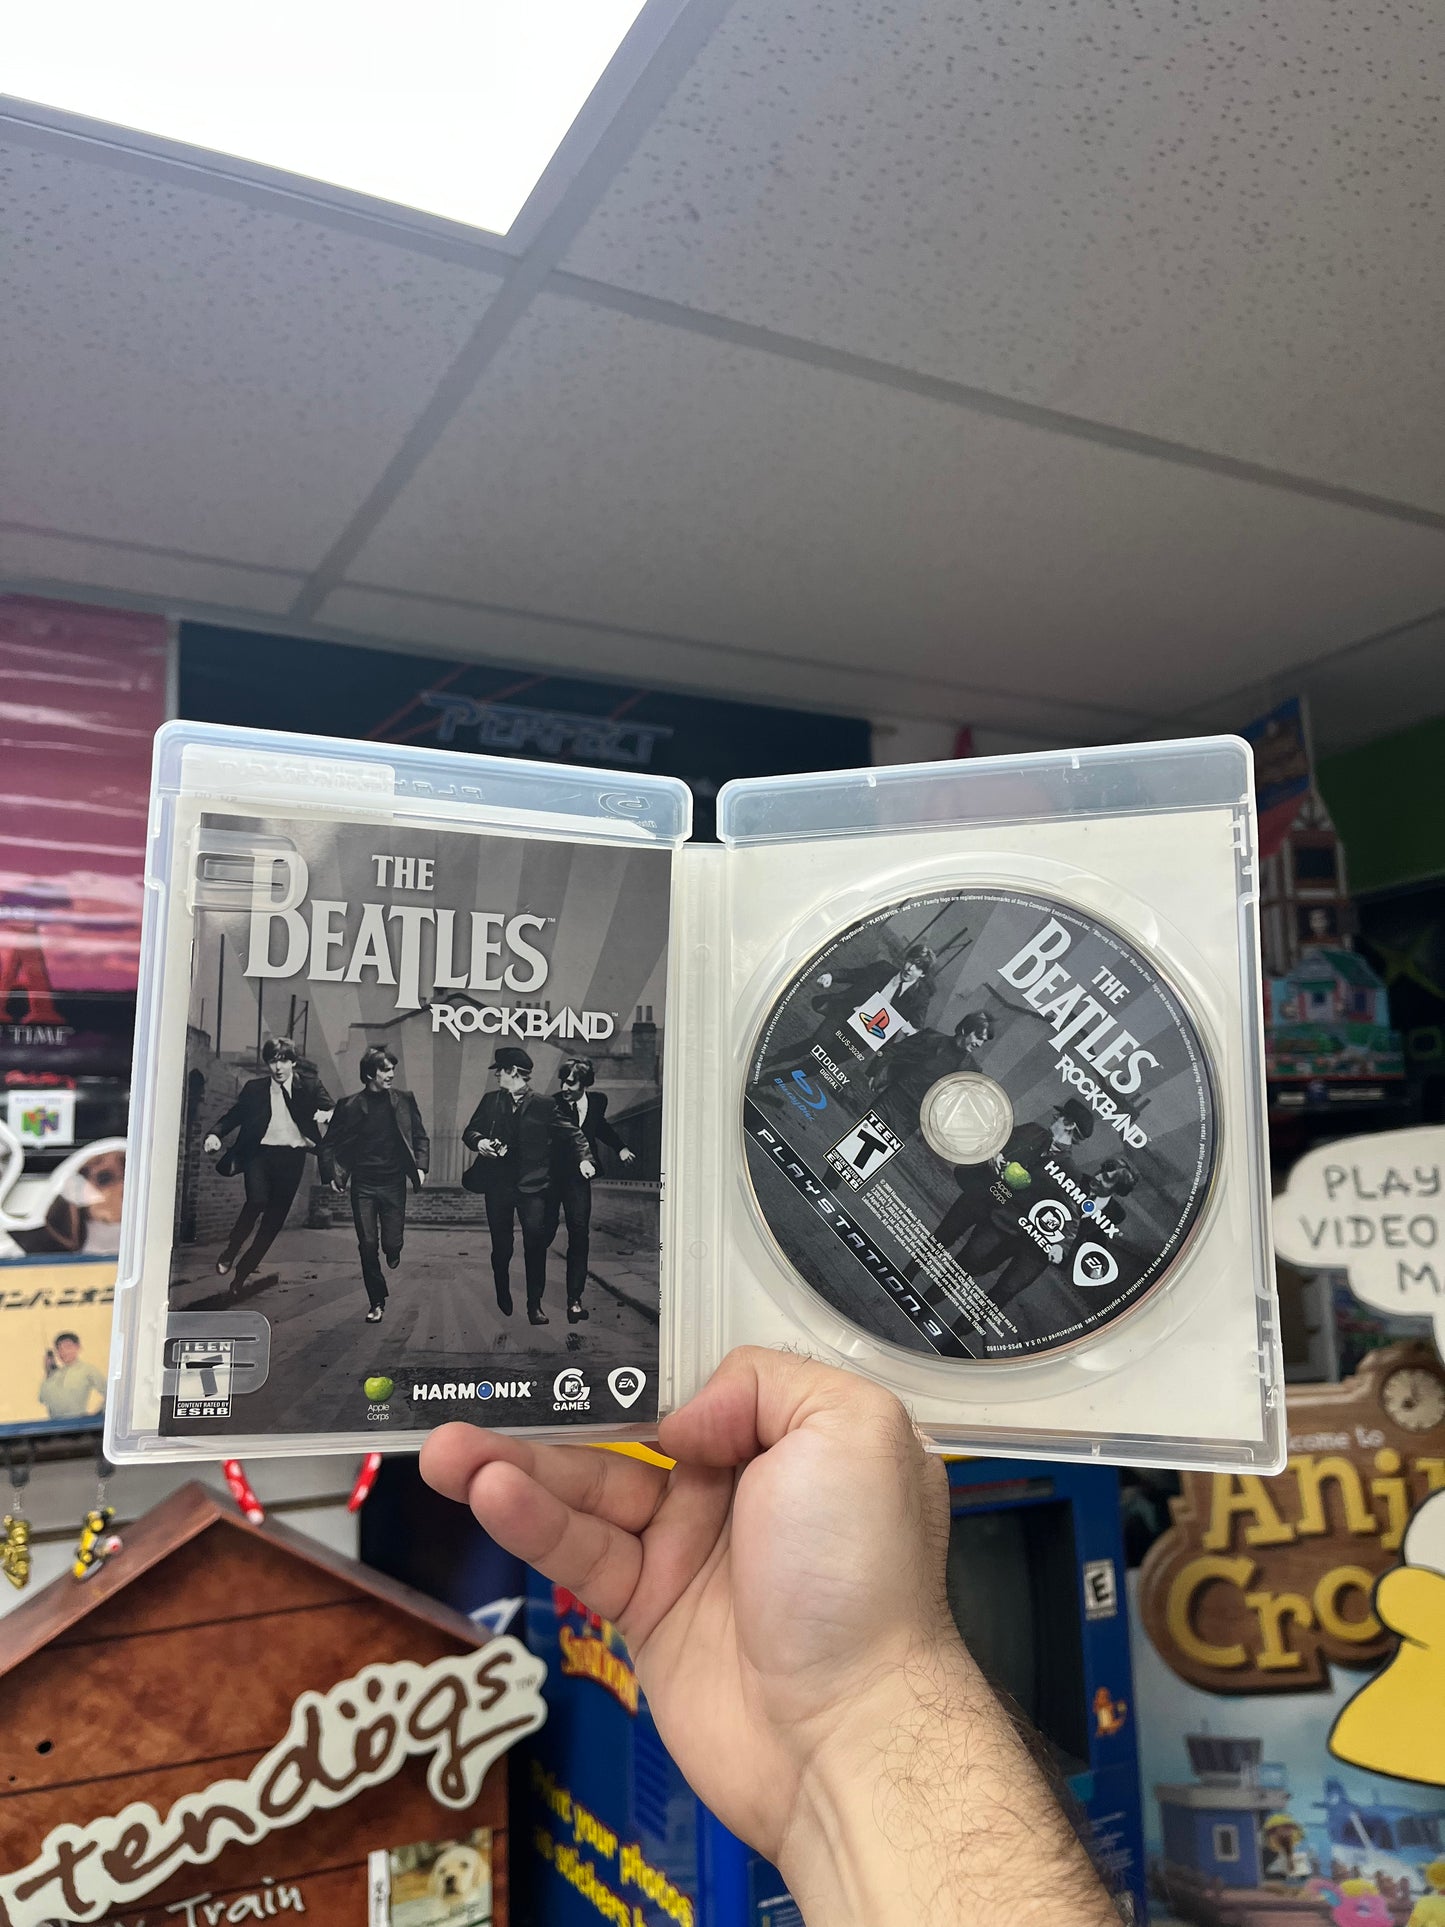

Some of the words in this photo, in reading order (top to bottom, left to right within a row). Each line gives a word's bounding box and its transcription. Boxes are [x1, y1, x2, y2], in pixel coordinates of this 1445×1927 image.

[372, 854, 435, 891] THE
[243, 848, 549, 1009] BEATLES
[1092, 965, 1131, 1005] THE
[997, 917, 1160, 1095] BEATLES
[759, 1043, 768, 1054] play
[923, 897, 939, 906] Family
[1177, 1202, 1193, 1228] broadcast
[818, 1068, 839, 1090] DIGITAL
[821, 1056, 850, 1086] DOLBY
[857, 1128, 889, 1170] T
[869, 1114, 901, 1150] TEEN
[827, 1153, 859, 1189] ESRB
[1323, 1164, 1440, 1200] PLAY
[989, 1186, 1007, 1204] Corps
[997, 1181, 1012, 1199] Apple
[1044, 1160, 1119, 1239] HARMONIX
[757, 1128, 921, 1312] PLAYSTATION
[1018, 1217, 1052, 1253] GAMES
[1299, 1213, 1438, 1249] VIDEO
[1397, 1259, 1445, 1294] M
[183, 1342, 231, 1351] TEEN
[368, 1403, 390, 1413] Apple
[413, 1380, 532, 1402] HARMONIX
[553, 1401, 591, 1411] GAMES
[176, 1408, 229, 1416] ESRB
[367, 1412, 390, 1422] Corps
[1203, 1449, 1445, 1551] Ani
[165, 1876, 306, 1927] Train
